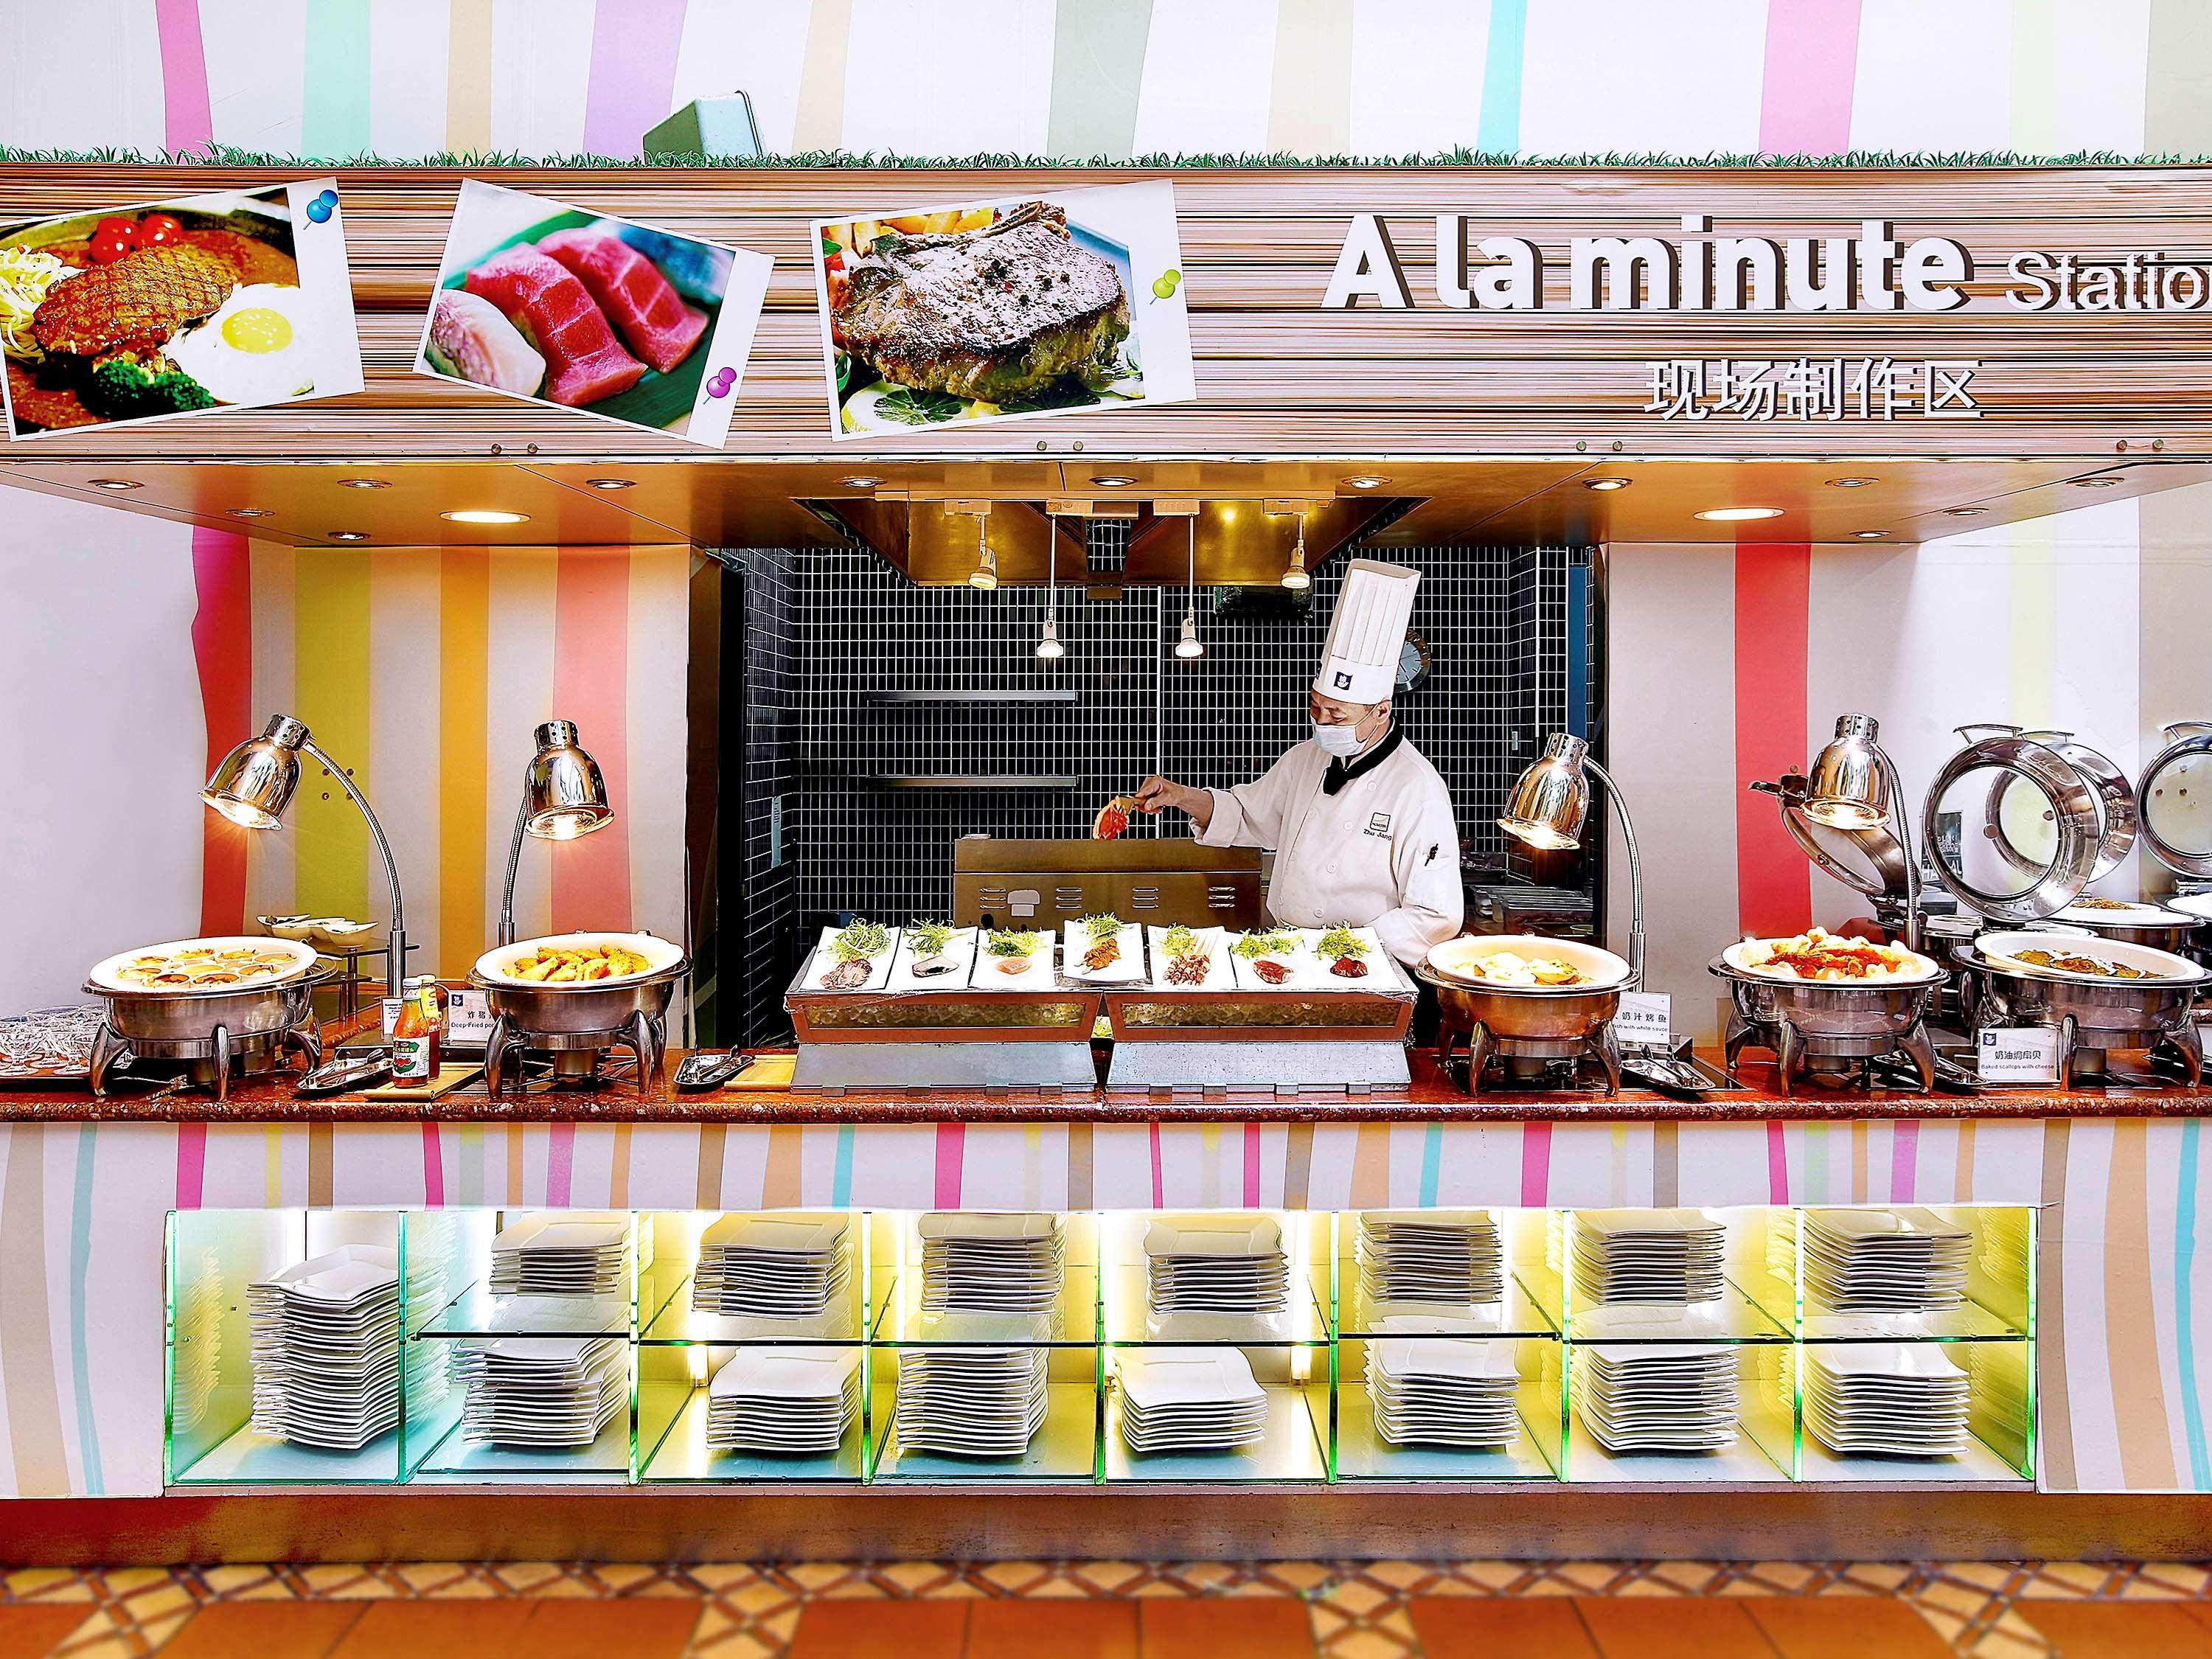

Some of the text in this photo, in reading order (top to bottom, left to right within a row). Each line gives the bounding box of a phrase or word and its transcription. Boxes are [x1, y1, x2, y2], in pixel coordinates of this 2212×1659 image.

[1319, 214, 2212, 310] A la minute Statio
[1644, 357, 1984, 422] 现场制作区
[467, 1010, 492, 1019] 炸猪
